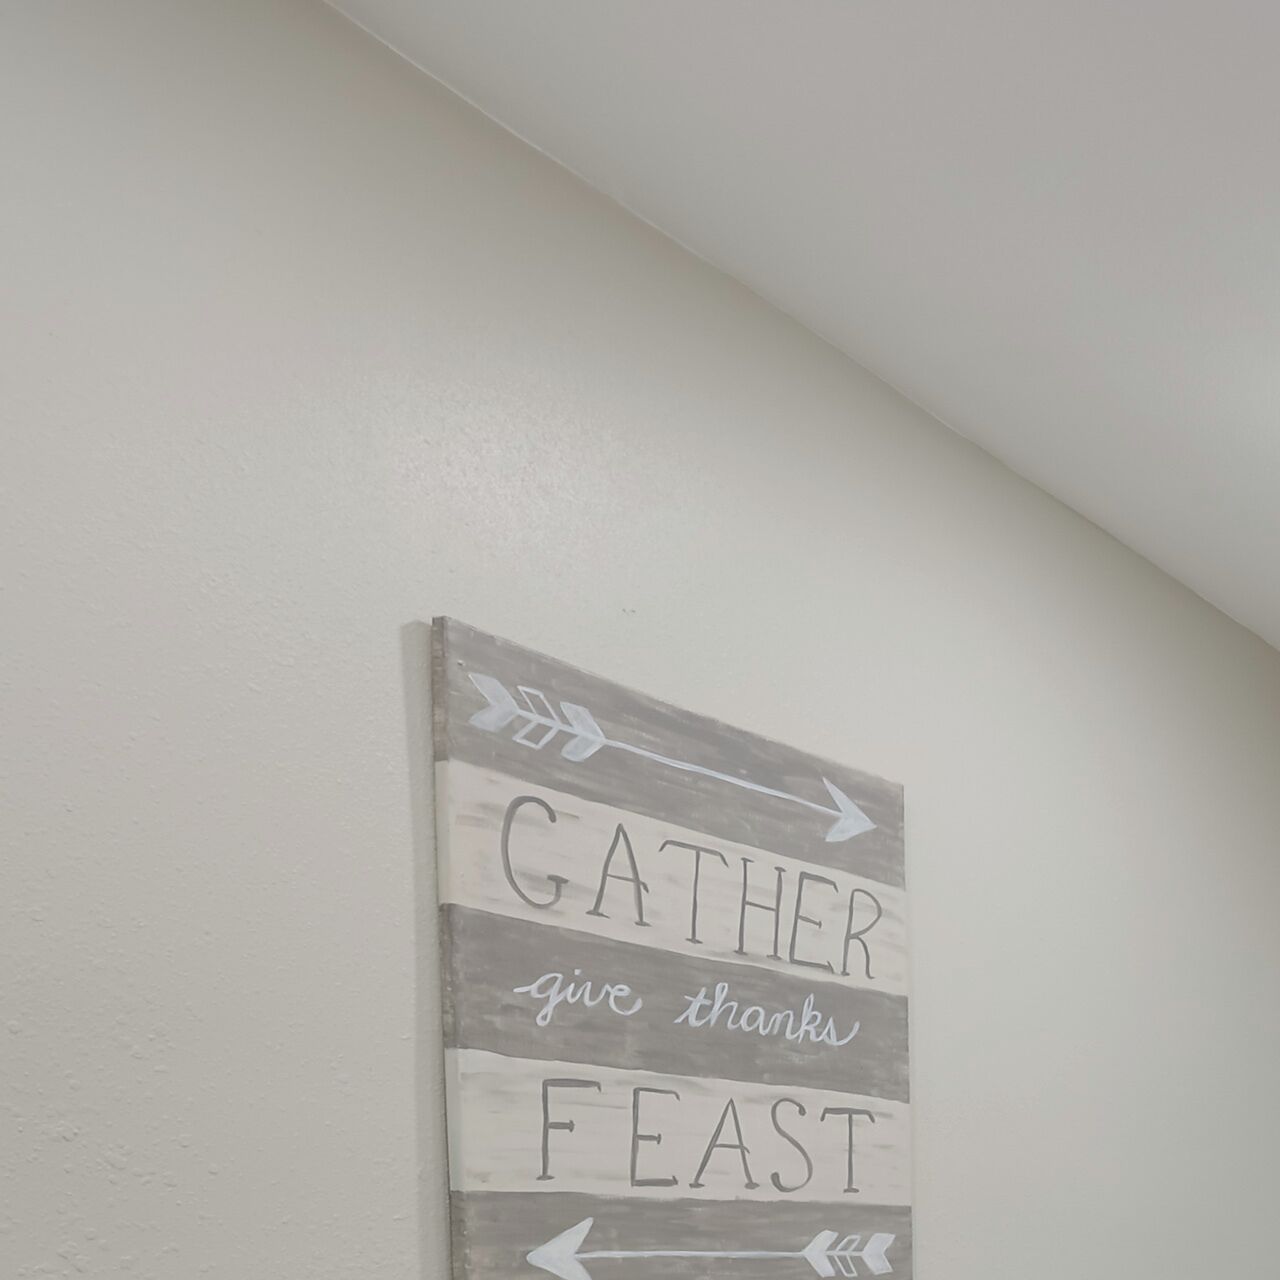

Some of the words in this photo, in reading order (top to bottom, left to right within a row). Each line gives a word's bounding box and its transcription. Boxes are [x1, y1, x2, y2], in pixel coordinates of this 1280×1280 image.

[500, 794, 882, 980] GATHER
[513, 968, 643, 1026] give
[673, 981, 860, 1047] thanks
[536, 1077, 875, 1195] FEAST
